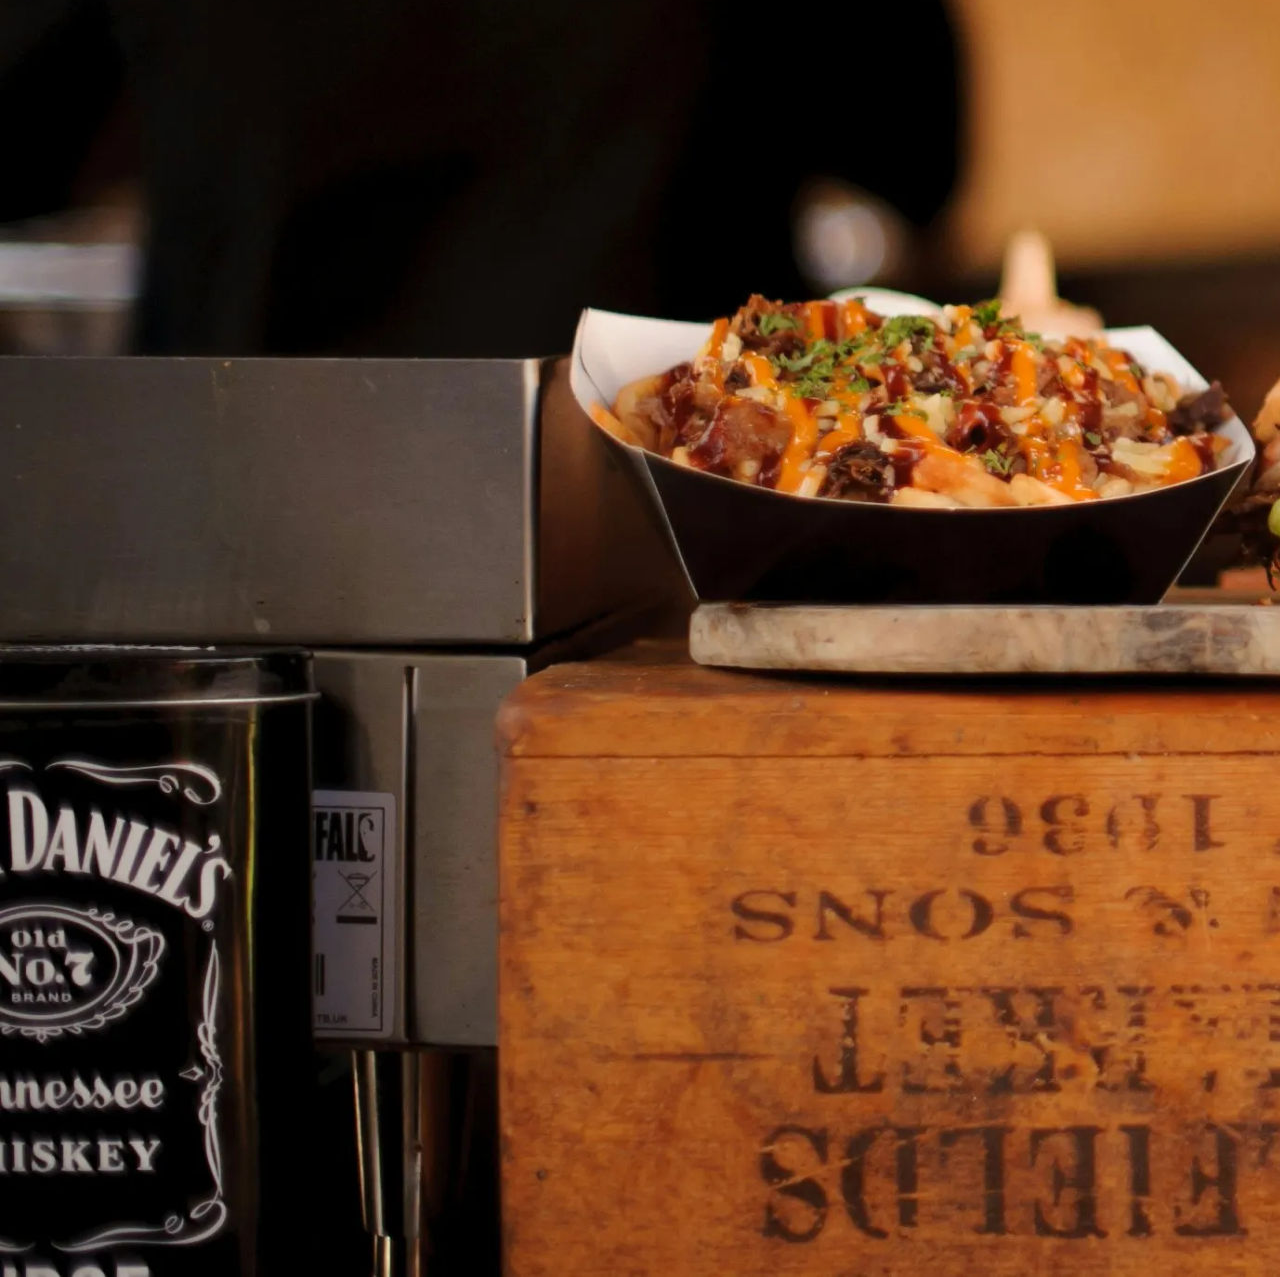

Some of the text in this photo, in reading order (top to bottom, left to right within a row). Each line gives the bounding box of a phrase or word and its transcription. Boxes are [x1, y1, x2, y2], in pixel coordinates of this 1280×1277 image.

[966, 792, 1226, 856] 1936
[7, 790, 233, 919] DANIEL'S
[730, 885, 1076, 943] SONS
[1123, 884, 1220, 937] &
[12, 992, 72, 1003] BRAND
